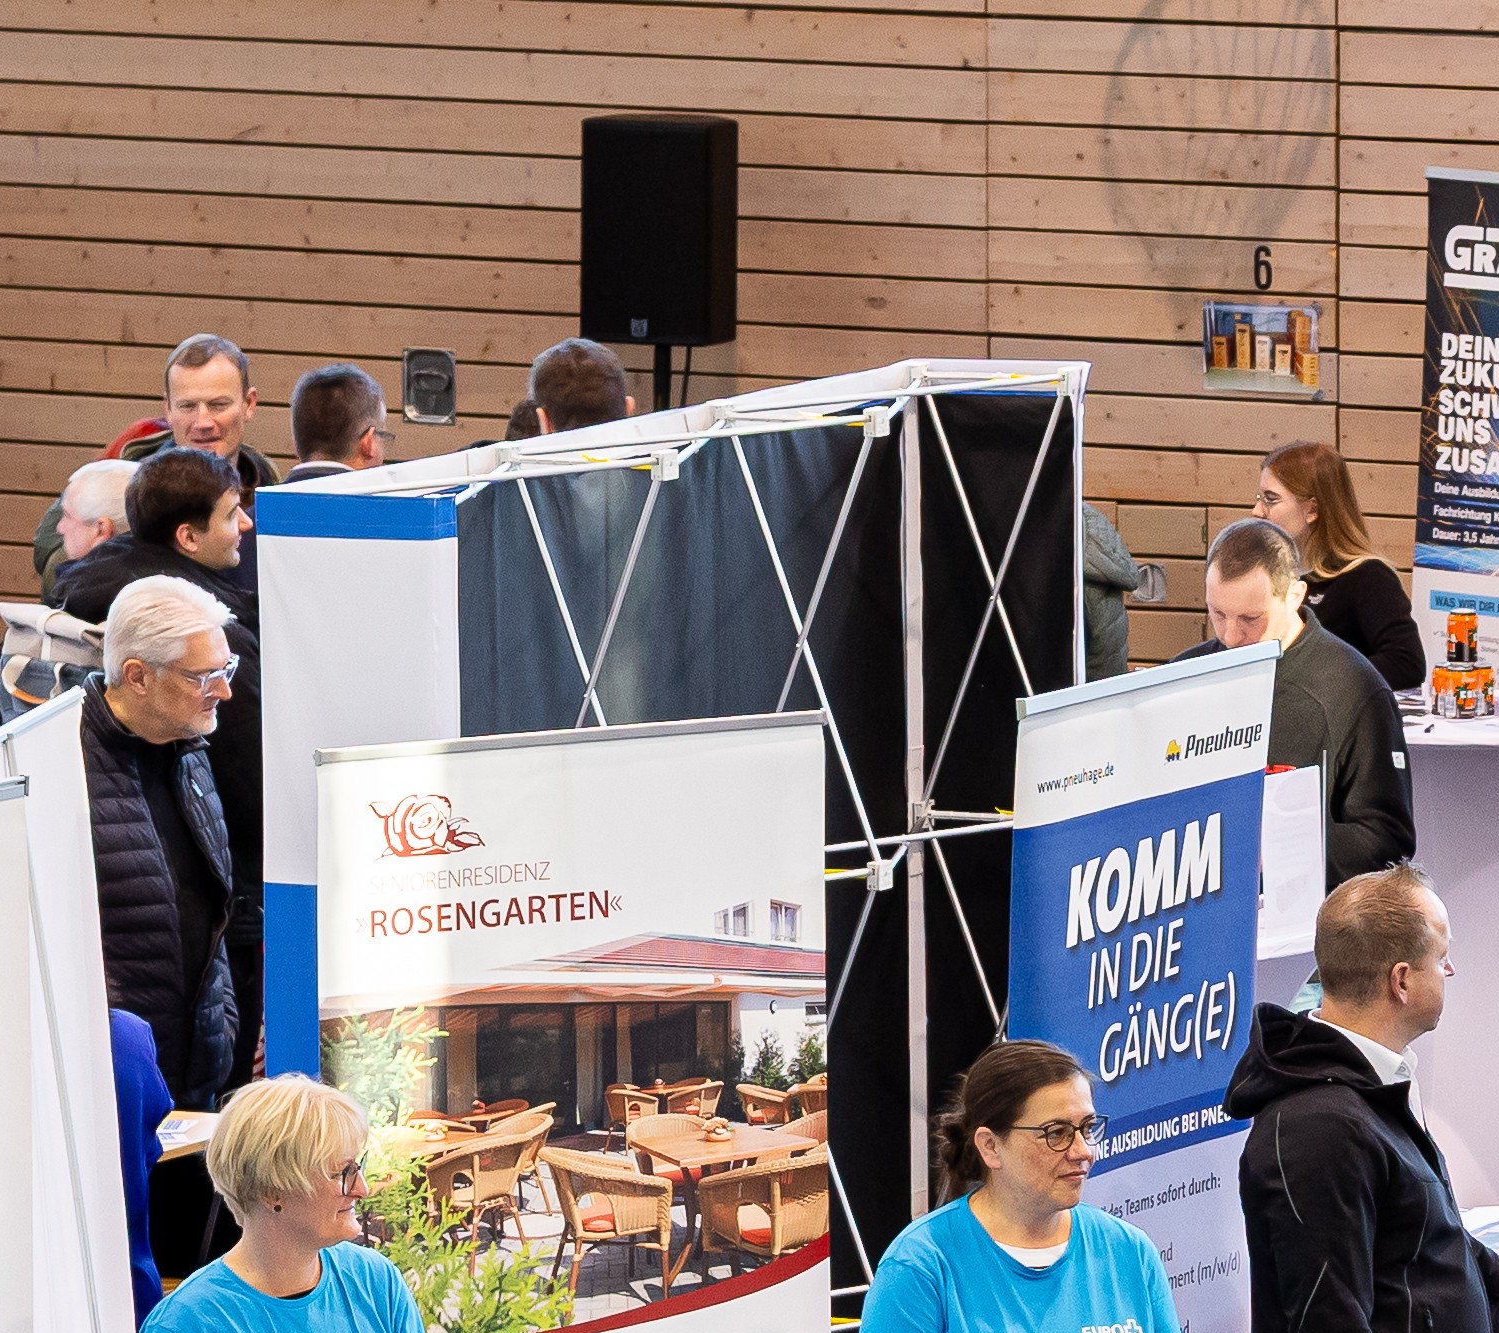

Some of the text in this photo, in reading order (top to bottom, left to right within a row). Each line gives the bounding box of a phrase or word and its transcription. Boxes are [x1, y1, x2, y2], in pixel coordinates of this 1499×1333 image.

[1253, 245, 1273, 291] 6
[1438, 416, 1491, 444] UNS
[1434, 482, 1459, 495] Deine
[1433, 505, 1491, 523] Fachrichtung
[1432, 527, 1461, 541] Dauer:
[1184, 722, 1263, 760] Pneuhage
[1037, 762, 1114, 794] www.pneuhage.de
[1066, 811, 1222, 949] KOMM
[1087, 918, 1184, 1009] IN DIE
[1099, 970, 1236, 1084] GÄNG(E)
[1111, 1112, 1198, 1156] AUSBILDUNG BEI
